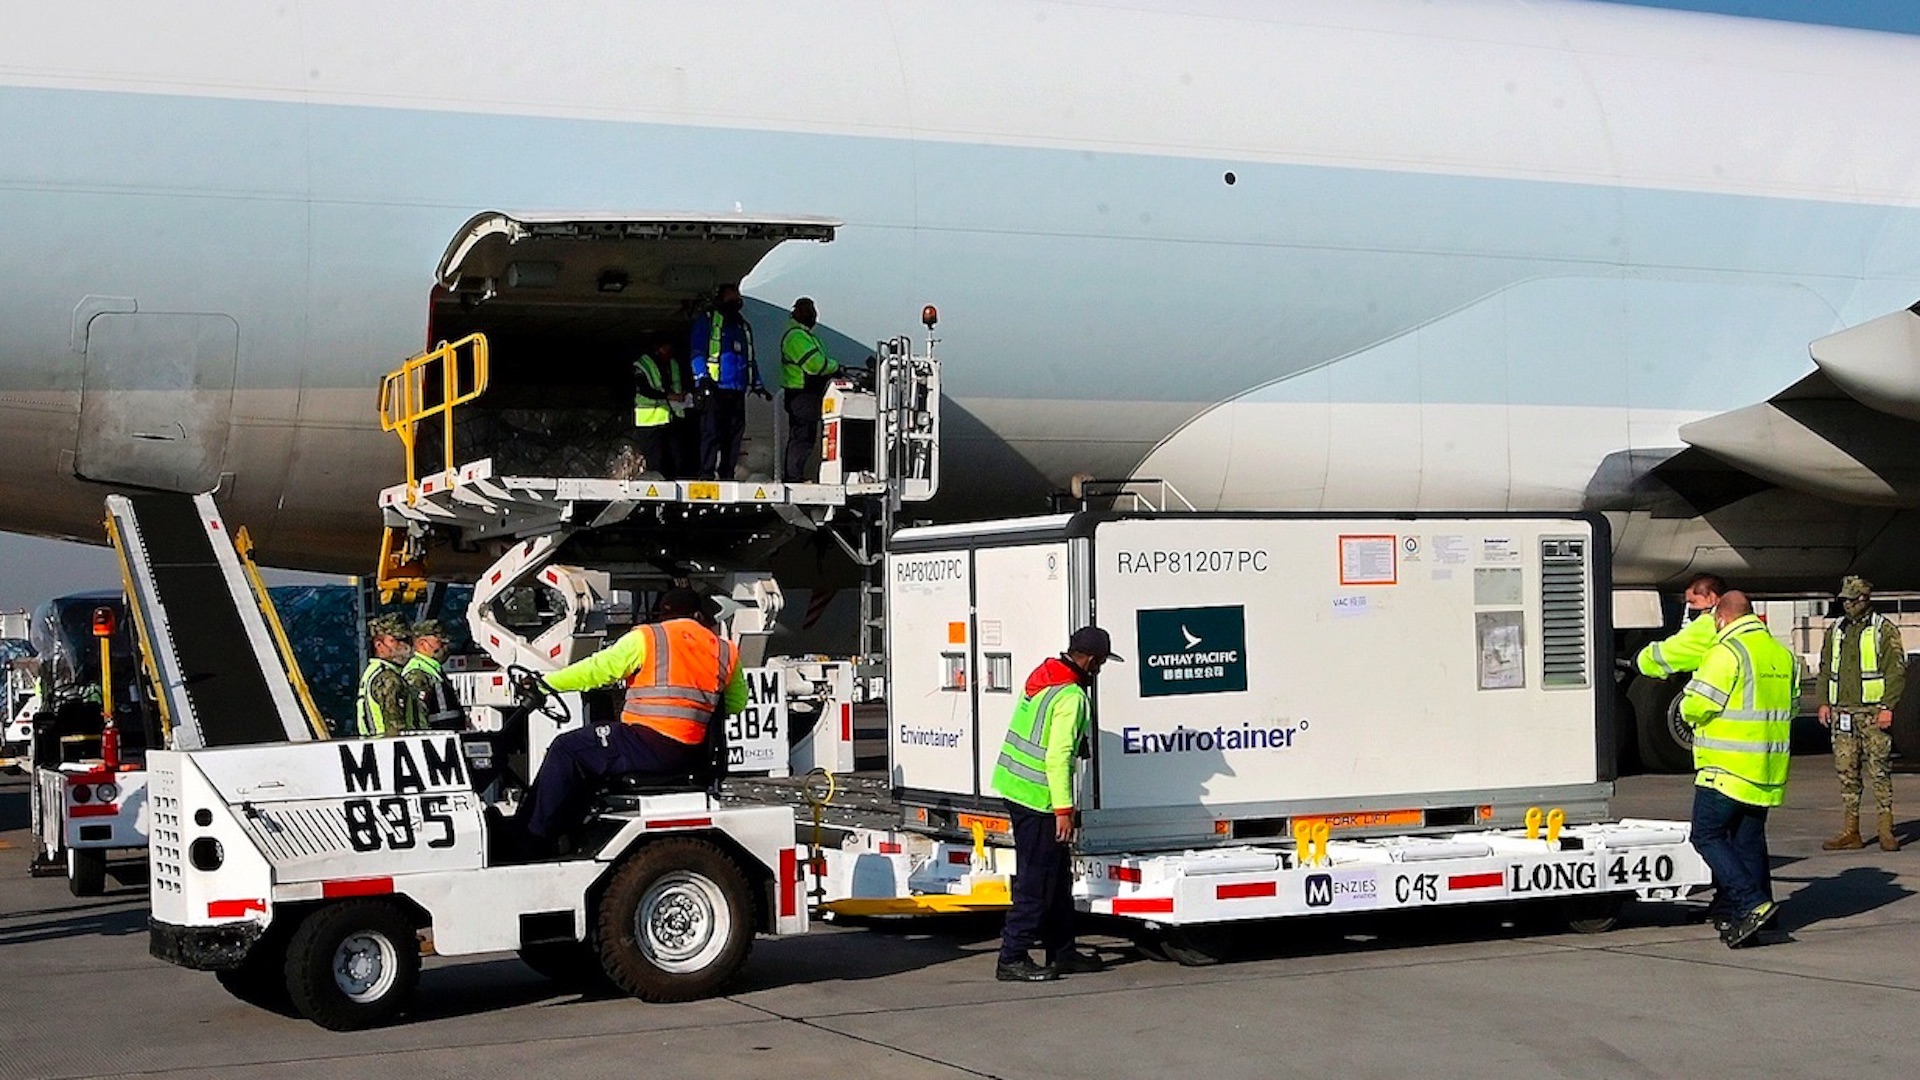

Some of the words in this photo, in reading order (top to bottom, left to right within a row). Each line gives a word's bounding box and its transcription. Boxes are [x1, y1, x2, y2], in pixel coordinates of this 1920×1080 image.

[897, 559, 963, 582] RAP81207PC
[1117, 551, 1268, 573] RAP81207PC
[1147, 654, 1194, 667] CATHAY
[1195, 650, 1238, 664] PACIFIC
[746, 672, 779, 704] AM
[338, 737, 466, 795] MAM
[344, 796, 455, 852] 835
[1325, 815, 1358, 826] FORK
[1364, 813, 1390, 824] LIFT
[1396, 873, 1439, 903] C43
[1511, 862, 1597, 892] LONG
[1608, 855, 1673, 885] 440
[1306, 875, 1377, 906] MENZIES
